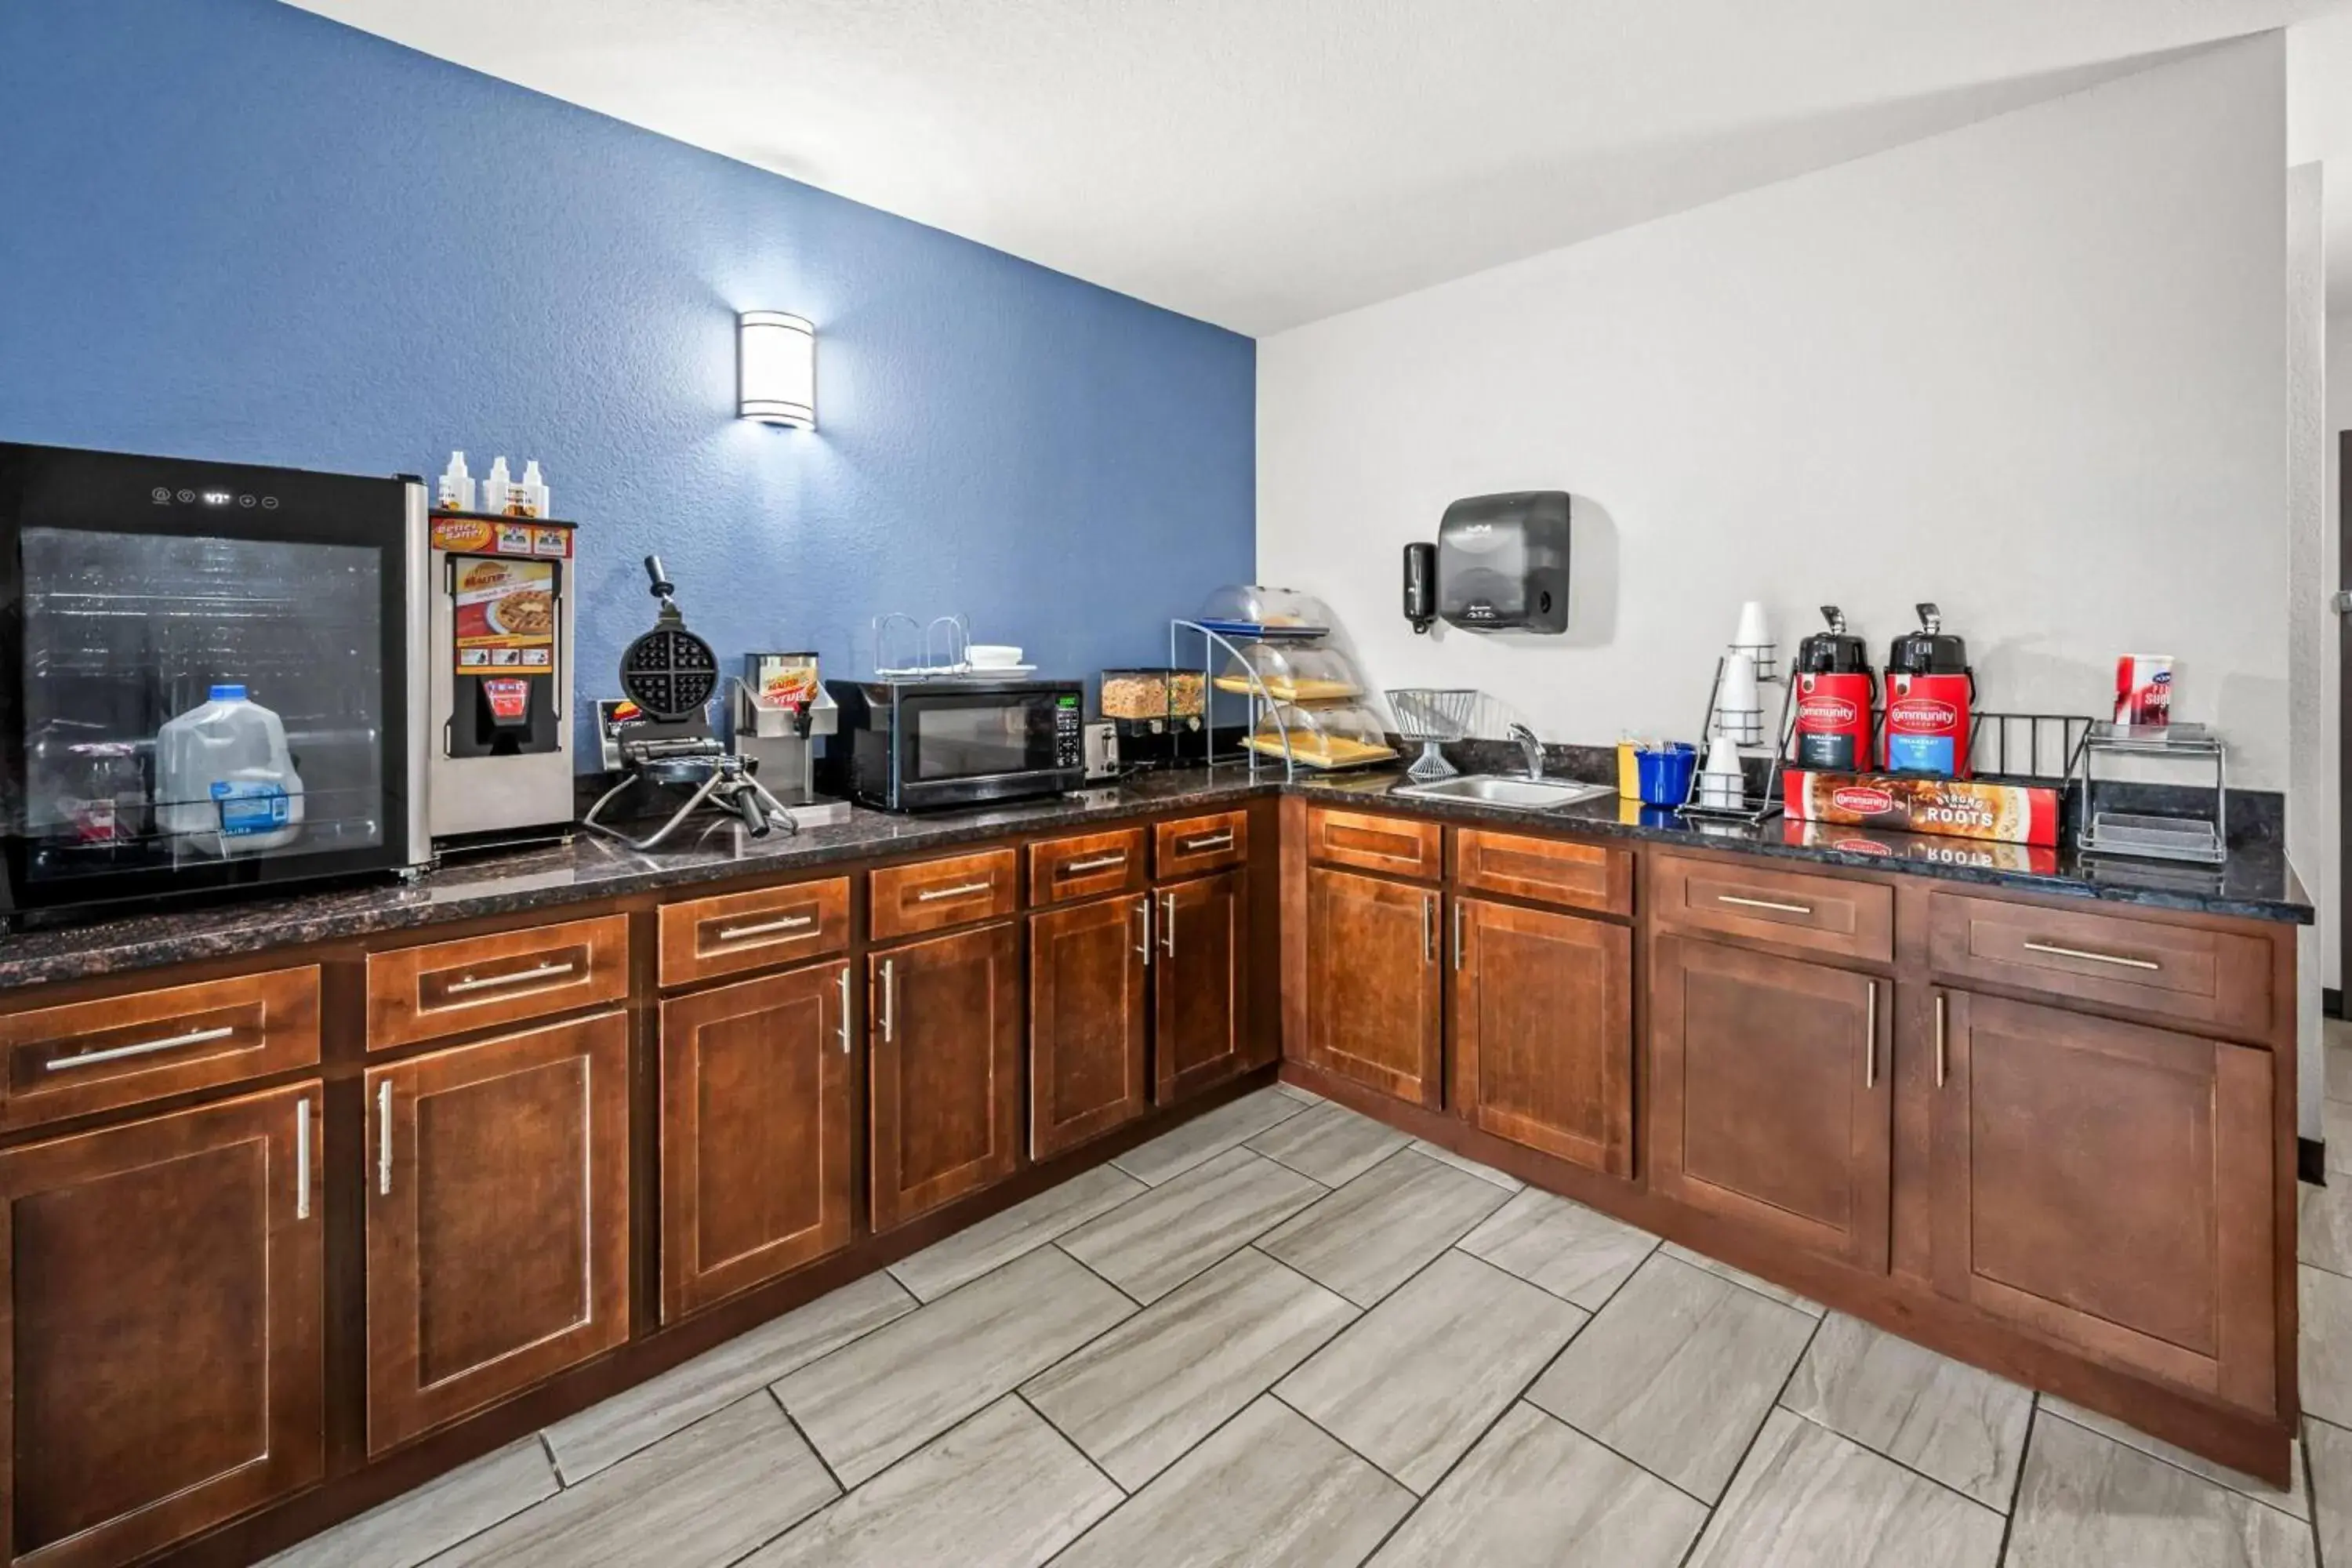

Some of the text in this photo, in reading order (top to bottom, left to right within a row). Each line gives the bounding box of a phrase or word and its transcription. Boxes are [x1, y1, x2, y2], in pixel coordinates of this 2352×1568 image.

[1799, 706, 1854, 720] Community
[1892, 708, 1955, 724] Community
[1836, 793, 1889, 809] Community
[1927, 807, 1994, 827] ROOTS
